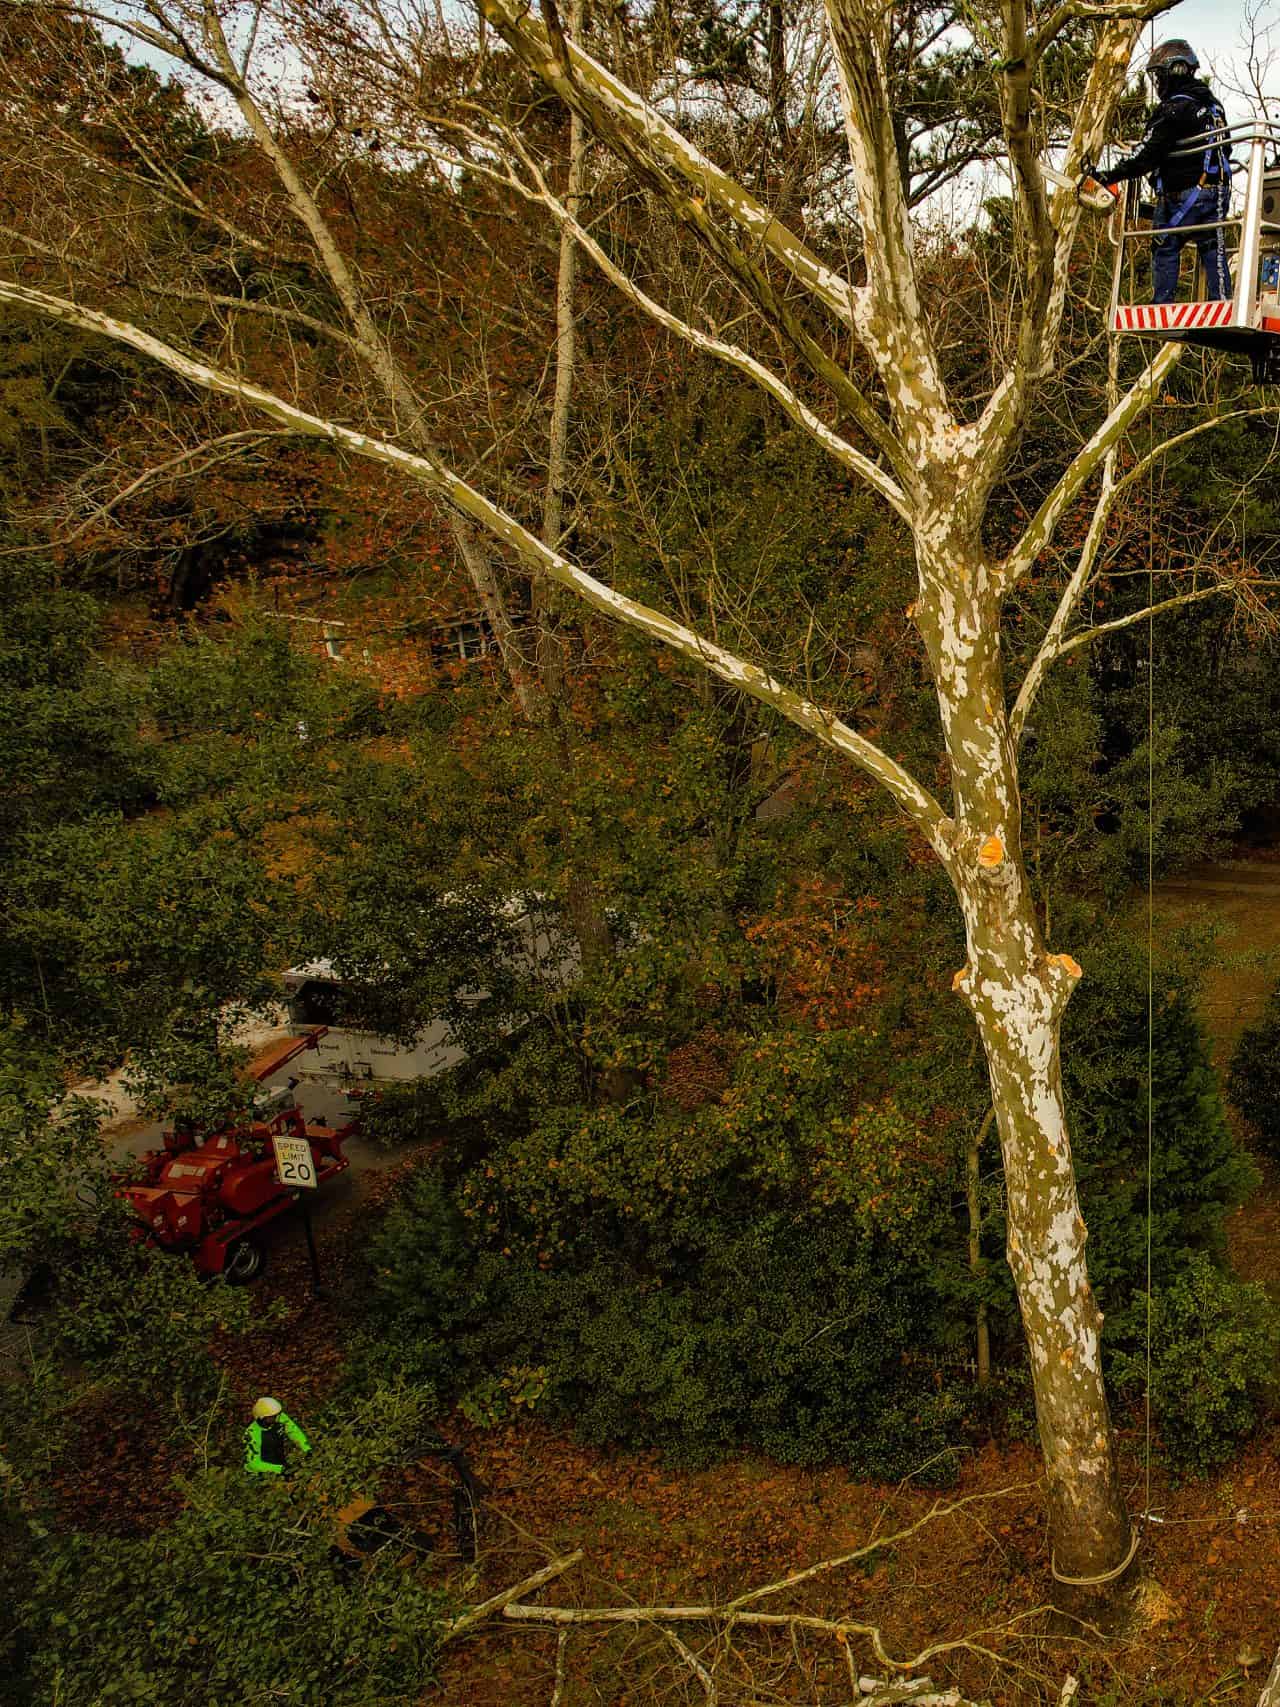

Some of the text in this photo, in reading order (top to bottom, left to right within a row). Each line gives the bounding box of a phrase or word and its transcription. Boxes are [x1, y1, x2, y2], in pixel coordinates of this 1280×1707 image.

[277, 1142, 307, 1153] SPEED
[282, 1153, 305, 1161] LIMIT
[282, 1162, 310, 1180] 20
